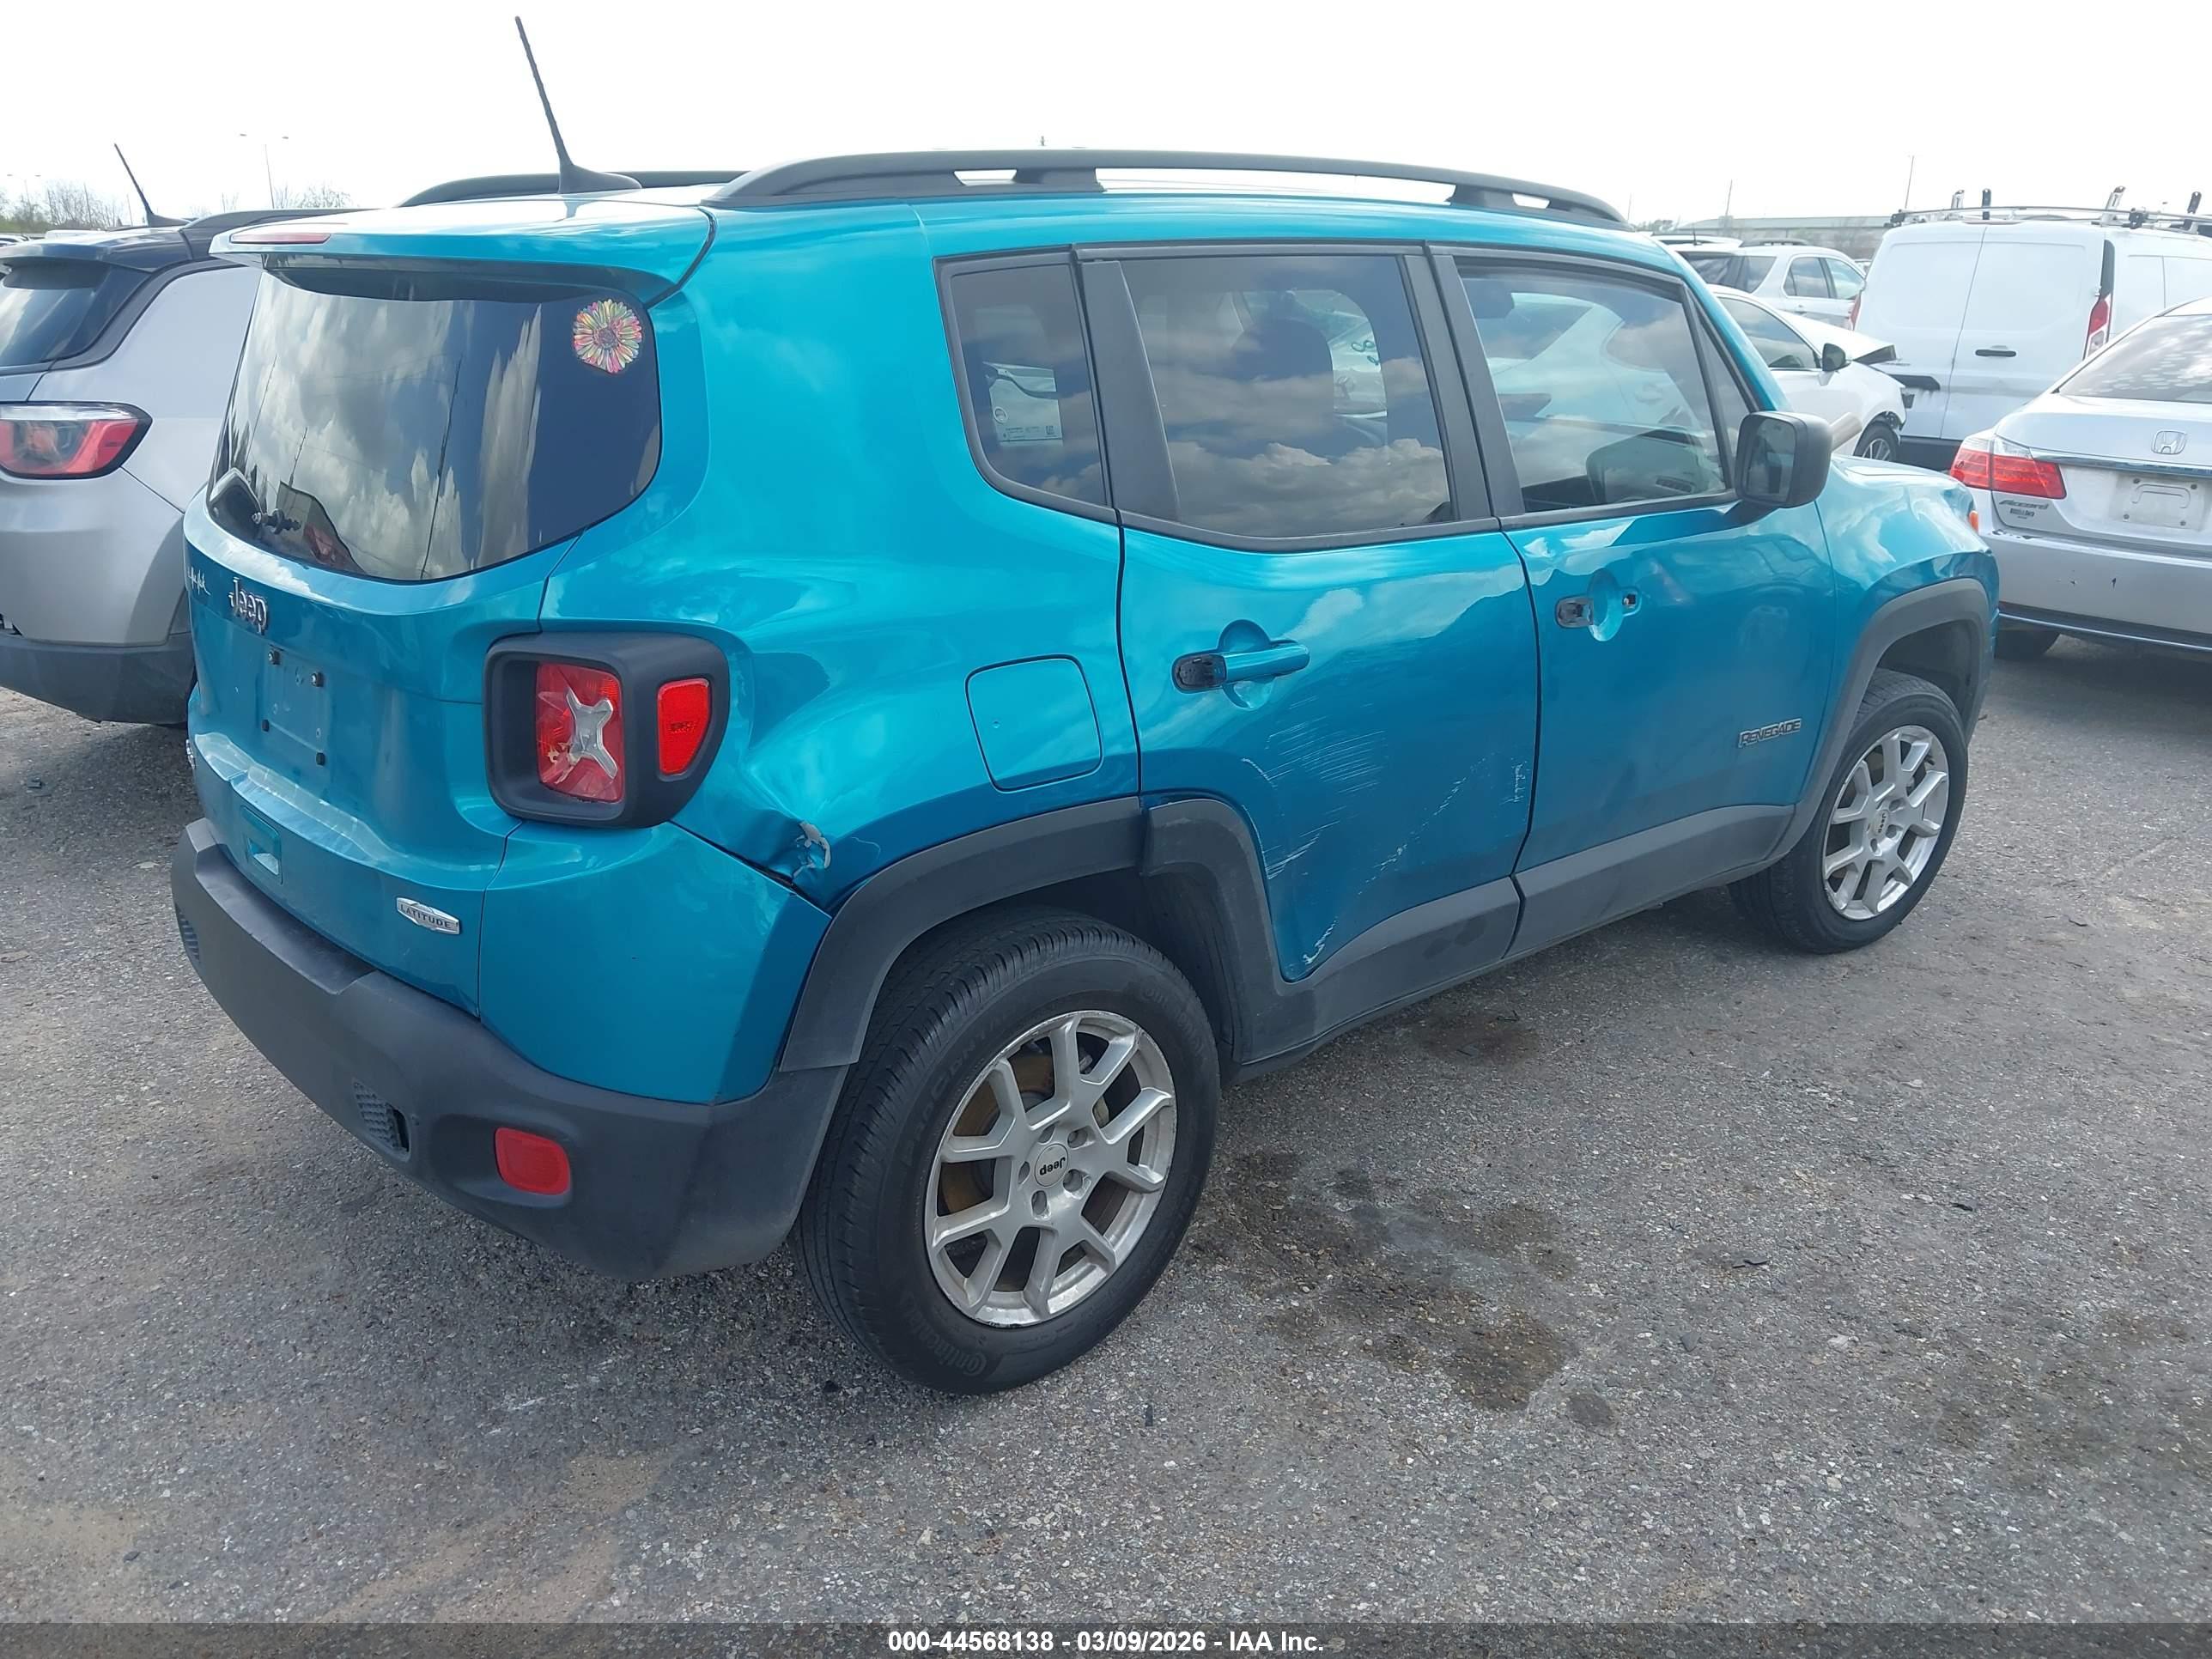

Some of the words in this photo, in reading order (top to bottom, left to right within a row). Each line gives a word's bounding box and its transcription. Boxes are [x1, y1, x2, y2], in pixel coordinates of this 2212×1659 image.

[228, 576, 267, 634] Jeep
[1738, 718, 1802, 748] RENEGADE
[399, 903, 452, 928] LATITUDE
[1040, 1157, 1066, 1176] Jeep
